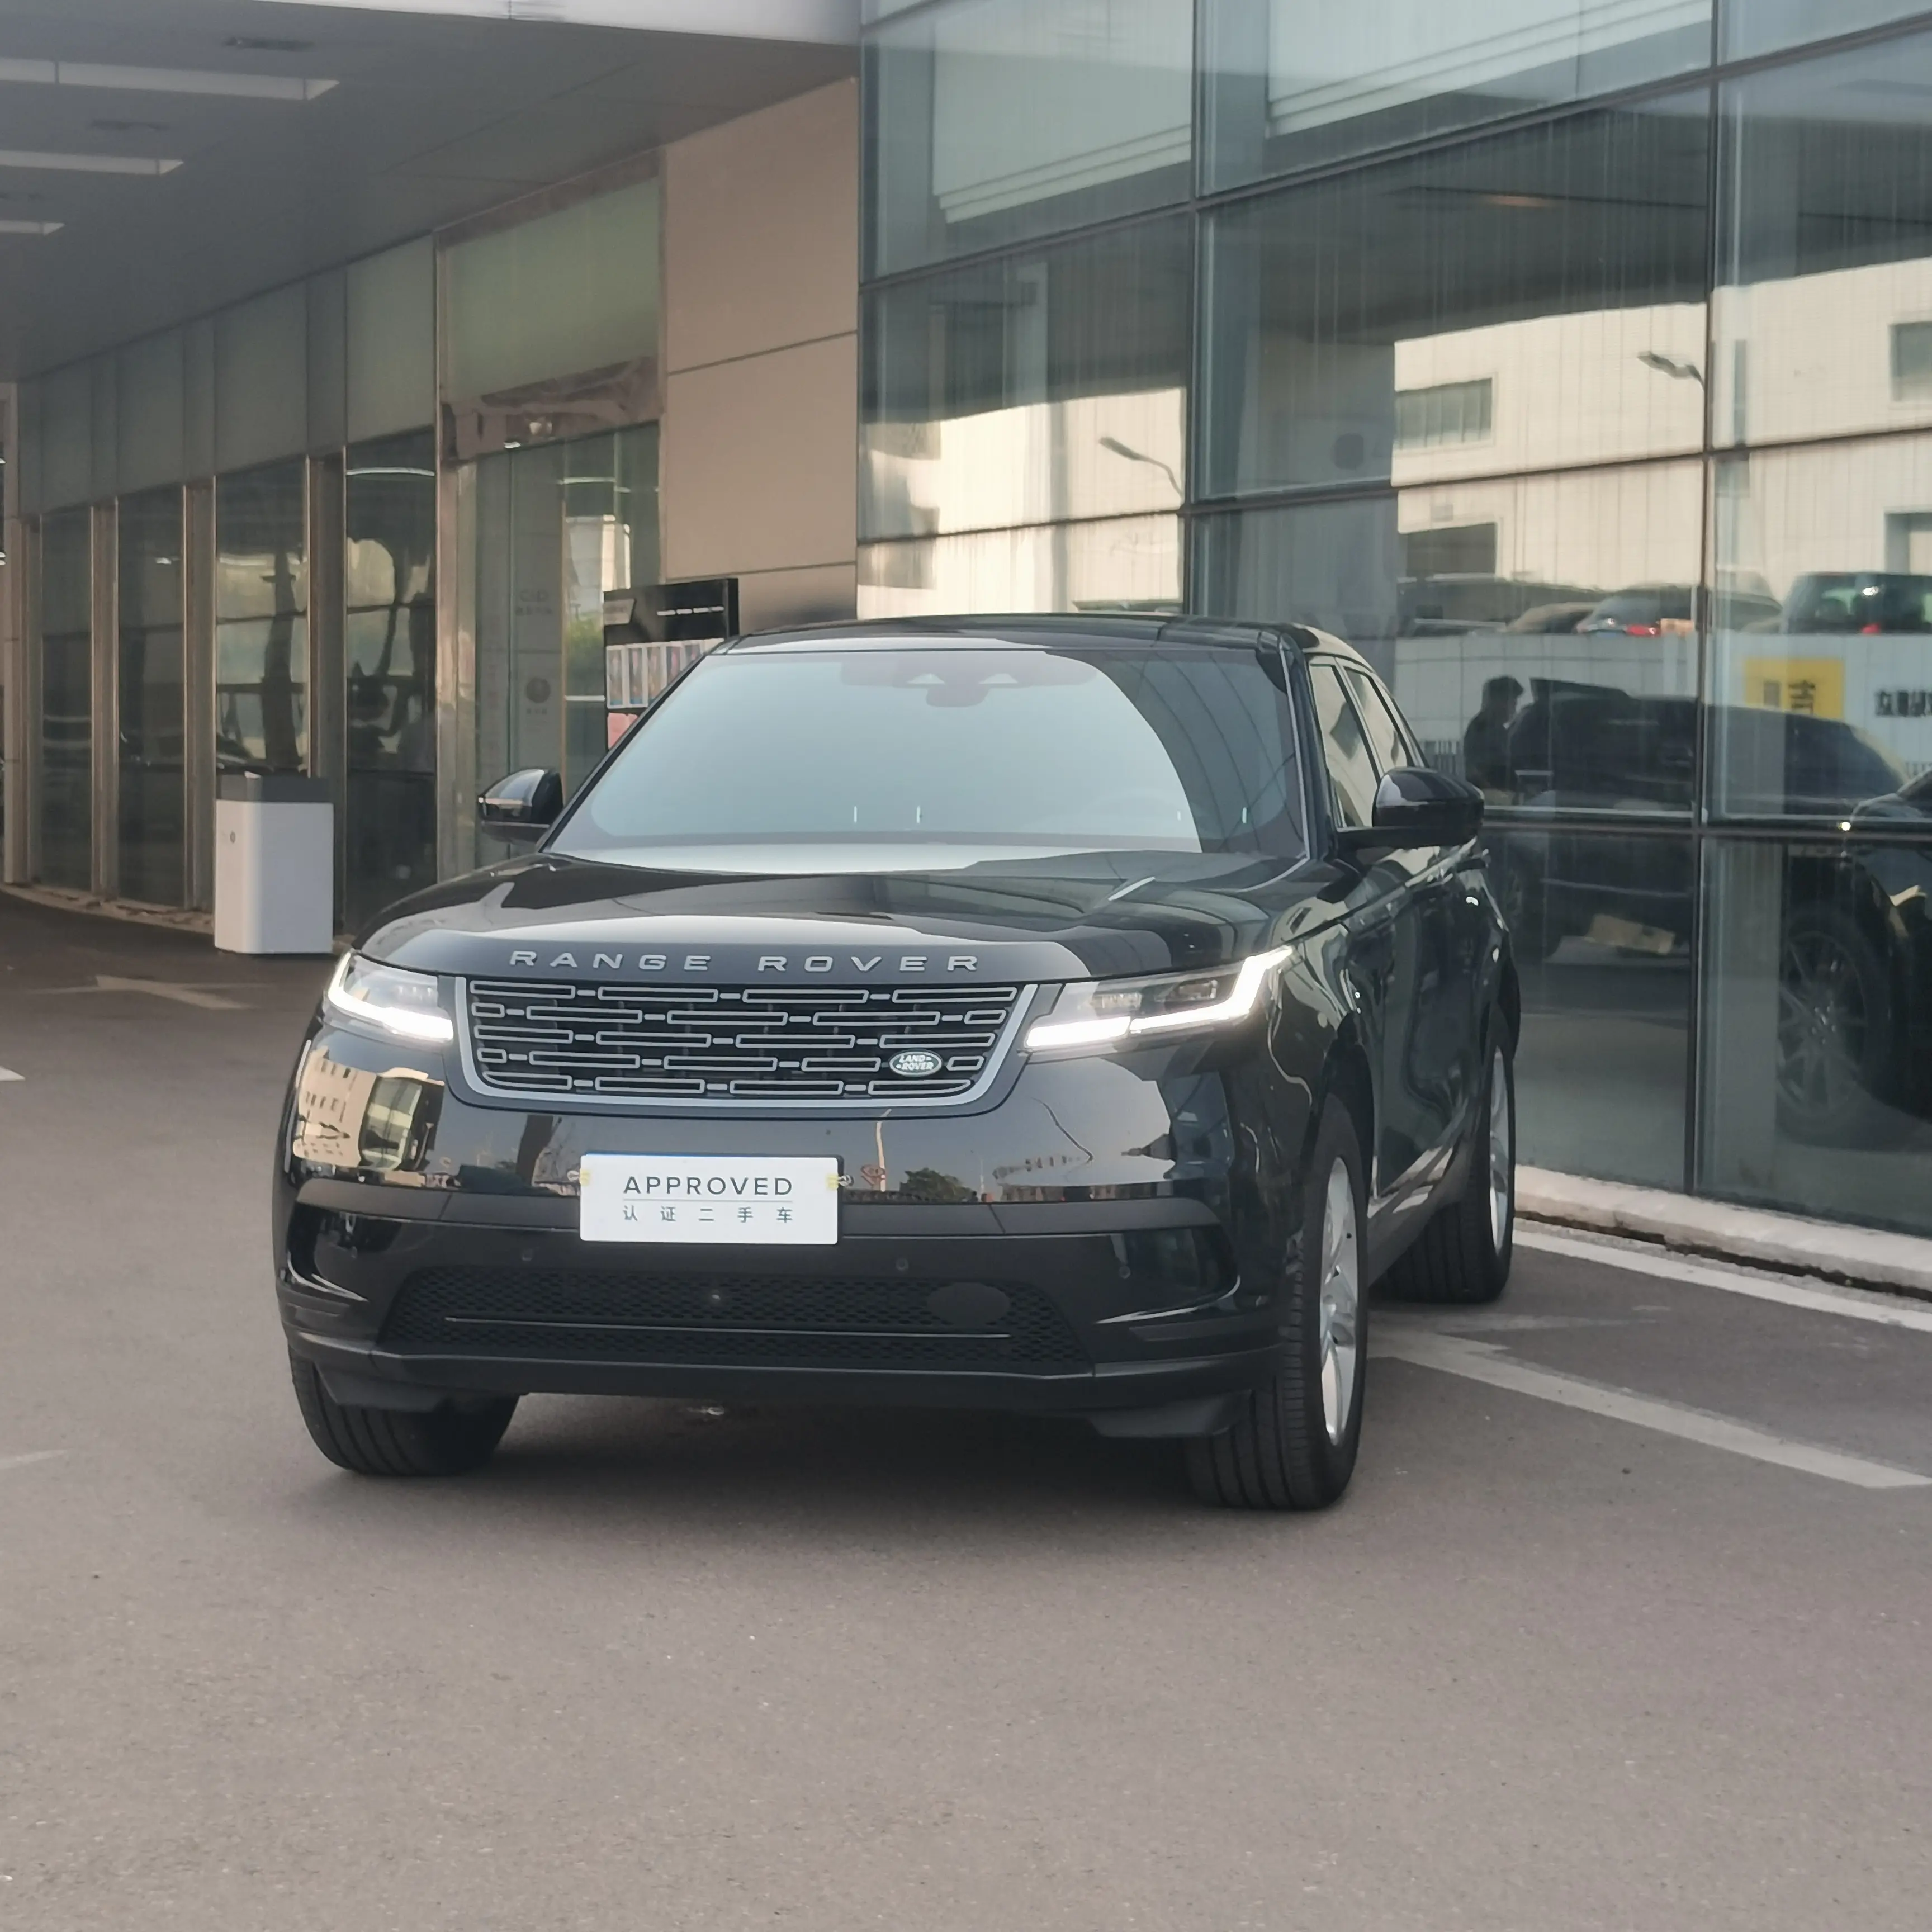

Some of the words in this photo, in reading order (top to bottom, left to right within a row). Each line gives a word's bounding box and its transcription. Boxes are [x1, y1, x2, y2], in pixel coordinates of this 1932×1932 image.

[509, 950, 712, 971] RANGE
[758, 956, 979, 972] ROVER
[623, 1176, 793, 1195] APPROVED
[623, 1205, 793, 1223] 认证二手车
